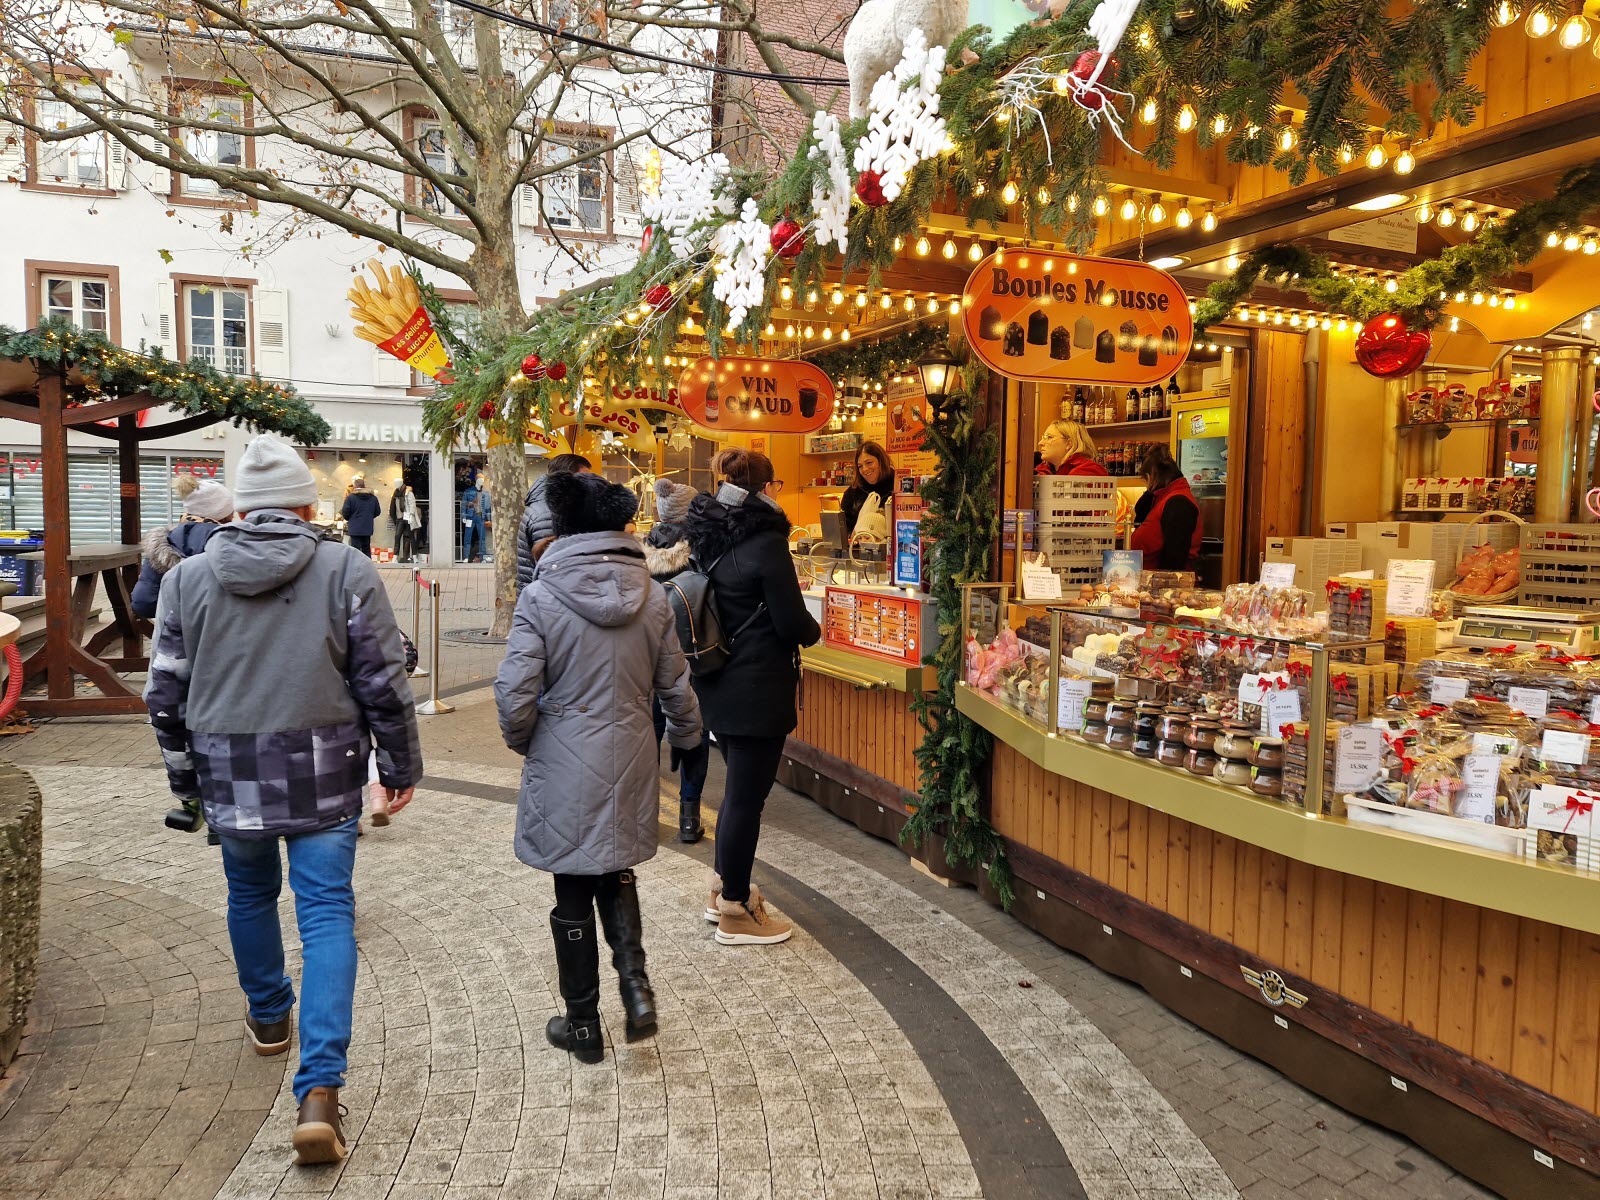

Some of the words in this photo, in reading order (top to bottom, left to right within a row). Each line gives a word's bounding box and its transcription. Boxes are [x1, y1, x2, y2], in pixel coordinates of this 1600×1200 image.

[991, 267, 1077, 303] Boules
[1084, 278, 1169, 312] Mousse
[391, 340, 407, 352] Les
[404, 316, 426, 341] délices
[406, 330, 429, 354] sucrés
[412, 339, 438, 365] Churros
[741, 376, 778, 395] VIN
[724, 395, 793, 415] CHAUD
[173, 463, 219, 477] CCV
[896, 503, 921, 512] GLÜHWEIN
